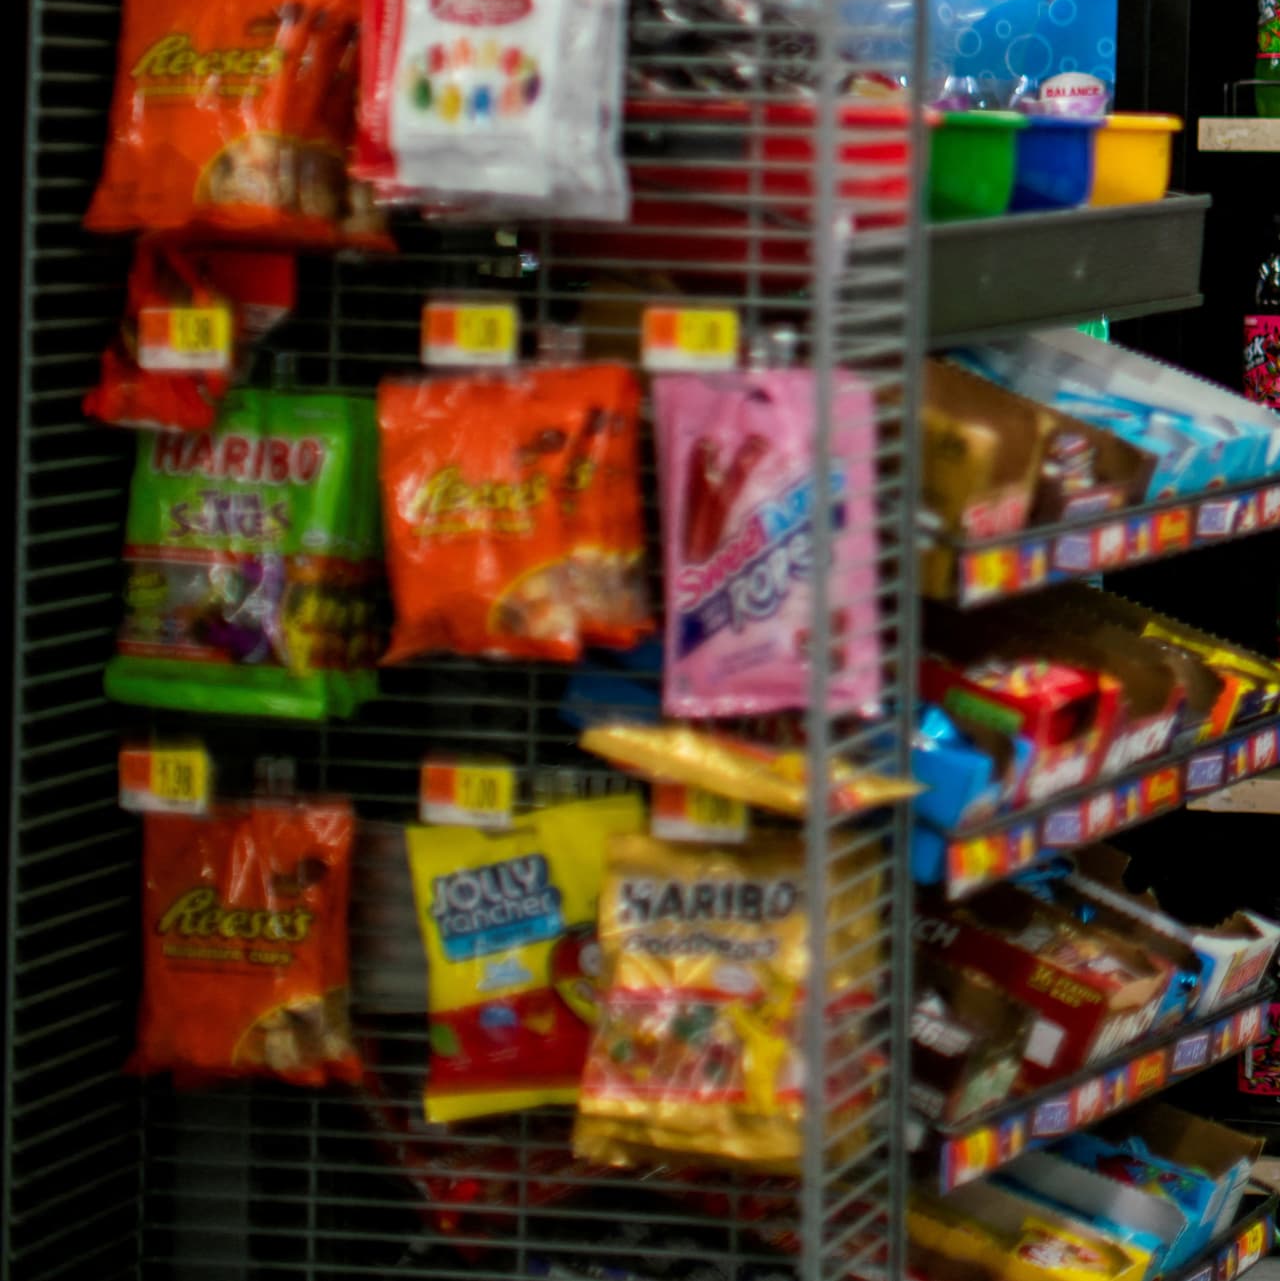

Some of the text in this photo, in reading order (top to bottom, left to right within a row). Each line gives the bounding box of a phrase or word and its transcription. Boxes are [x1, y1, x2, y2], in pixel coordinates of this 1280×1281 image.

[1046, 86, 1101, 100] BALANCE
[153, 432, 326, 484] HARIBO
[429, 855, 540, 917] JOLLY
[617, 877, 799, 924] HARIBO
[158, 888, 314, 942] Reese's
[439, 894, 553, 937] rancher
